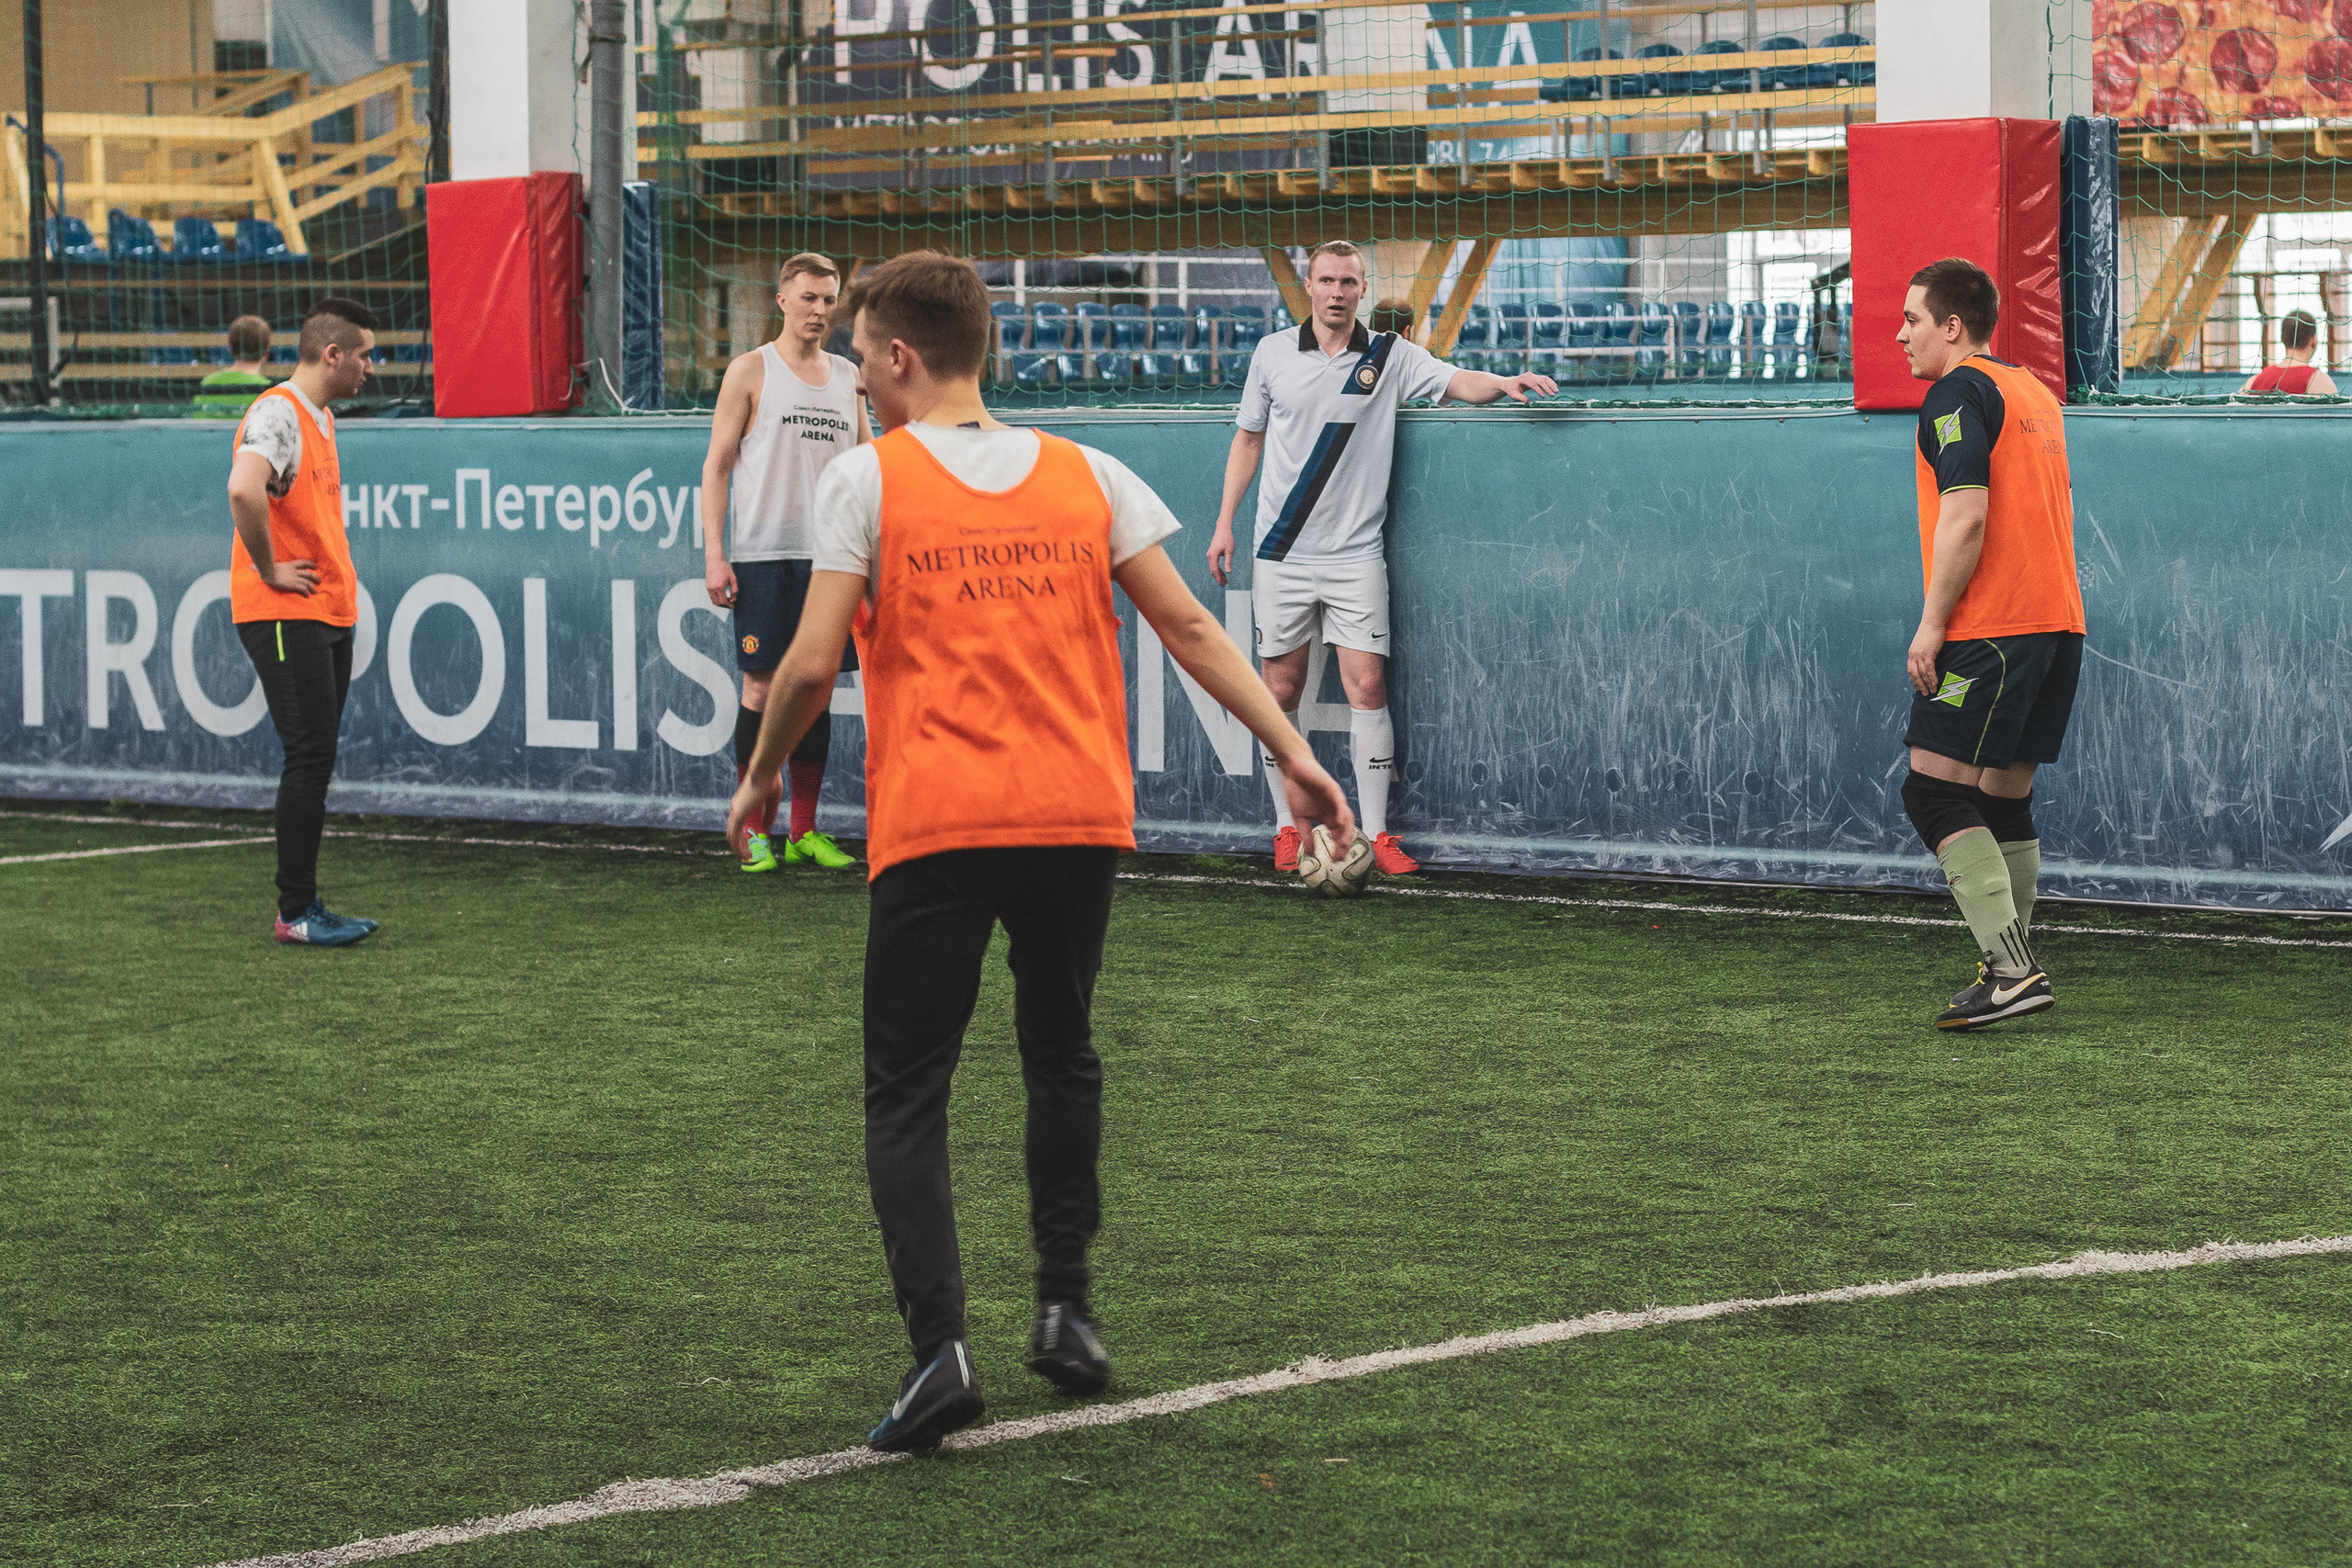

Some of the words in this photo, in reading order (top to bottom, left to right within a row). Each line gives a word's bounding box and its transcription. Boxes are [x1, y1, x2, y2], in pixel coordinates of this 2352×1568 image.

[782, 415, 849, 431] METROPOLIS
[801, 430, 835, 442] ARENA
[907, 540, 1093, 576] METROPOLIS
[956, 575, 1057, 604] ARENA
